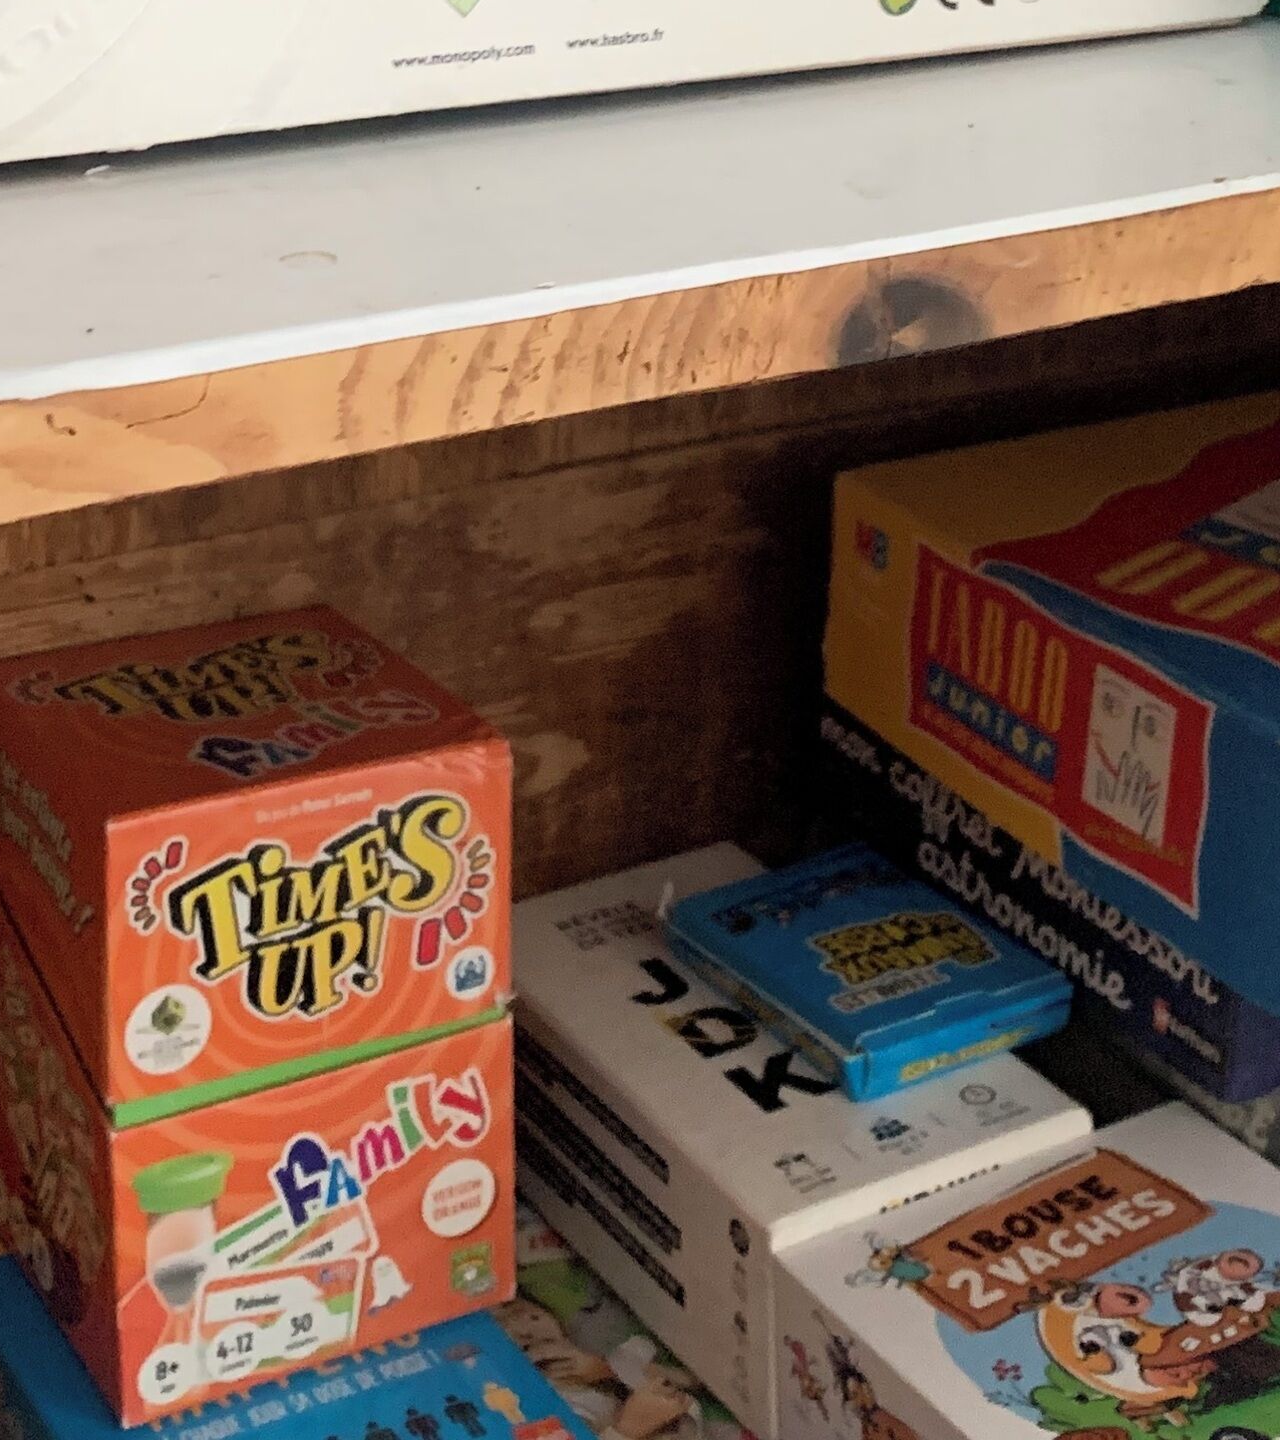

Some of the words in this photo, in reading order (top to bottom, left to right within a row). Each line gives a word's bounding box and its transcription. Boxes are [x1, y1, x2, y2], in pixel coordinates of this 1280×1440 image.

[392, 43, 536, 69] www.monopoly.com
[566, 28, 665, 50] www.hasbro.fr
[926, 566, 1068, 734] TABOO
[928, 670, 1054, 763] Junior
[888, 760, 1004, 862] coffret
[167, 791, 468, 981] TIME'S
[918, 839, 1133, 1011] astronomie
[245, 906, 386, 1019] UP!
[947, 1267, 1008, 1310] 2
[986, 1187, 1178, 1286] VACHES
[970, 1173, 1120, 1255] BOUSE
[155, 1361, 180, 1381] 8+
[216, 1331, 254, 1359] 4-12
